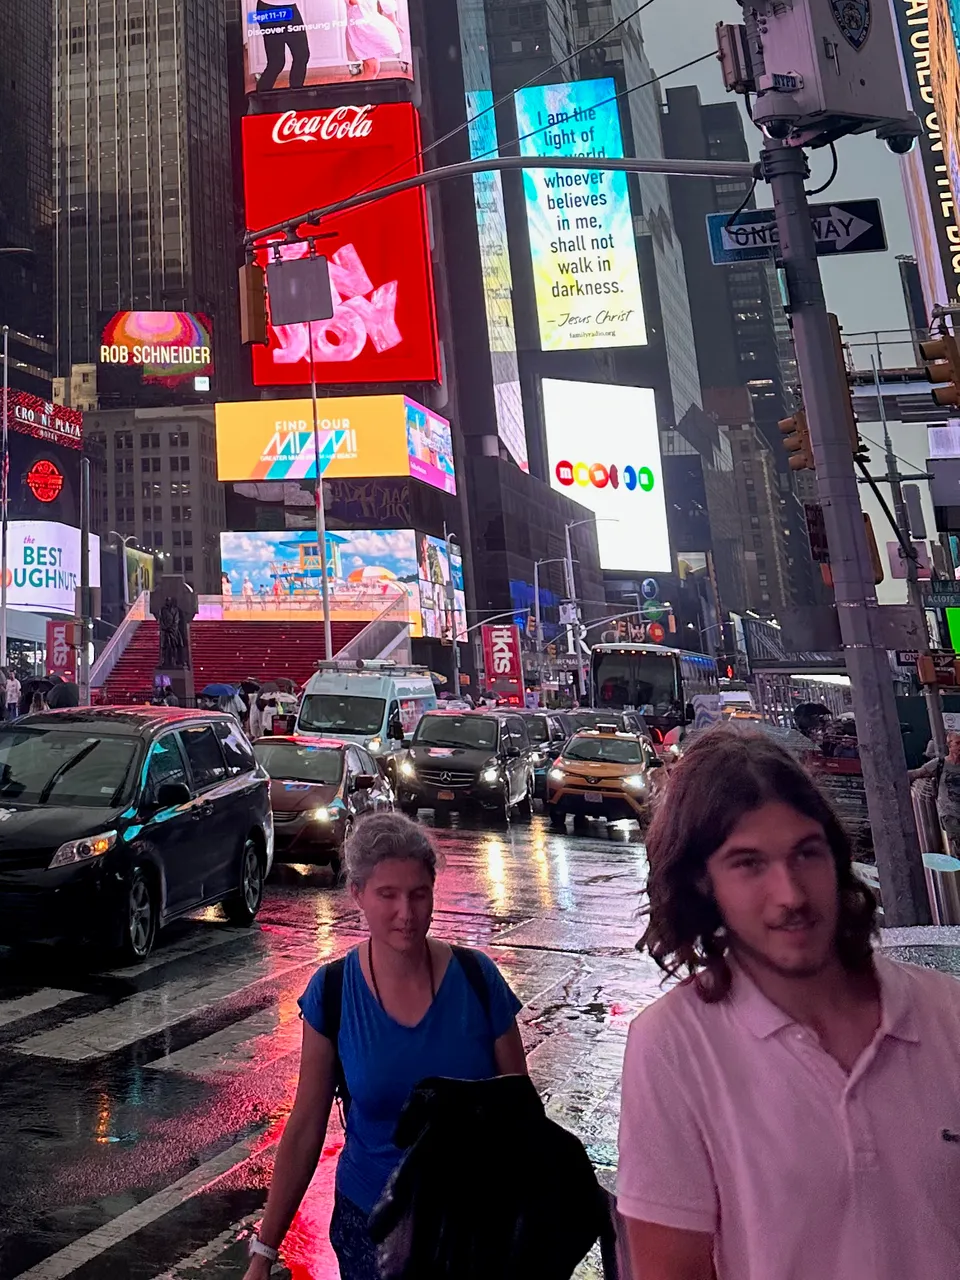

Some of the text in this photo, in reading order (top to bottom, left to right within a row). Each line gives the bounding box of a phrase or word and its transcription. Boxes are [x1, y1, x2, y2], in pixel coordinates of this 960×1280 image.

[252, 11, 287, 22] Sept 11-17
[248, 21, 331, 37] Discover Samsung
[773, 73, 796, 88] NYPD
[272, 104, 378, 144] Coca-Cola
[538, 107, 596, 127] I am the
[543, 126, 596, 149] light of
[543, 170, 606, 189] whoever
[547, 192, 607, 210] believes
[557, 216, 602, 231] in me,
[550, 234, 614, 253] shall not
[735, 224, 780, 246] ONE
[557, 255, 611, 275] walk in
[551, 279, 625, 298] darkness.
[557, 309, 633, 328] Jesus Christ
[100, 345, 211, 364] ROB SCHNEIDER
[54, 418, 82, 438] PLAZA
[275, 420, 307, 432] FIND
[263, 429, 358, 456] MIAMI
[23, 535, 36, 545] the
[23, 547, 63, 567] BEST
[491, 628, 514, 675] tkts
